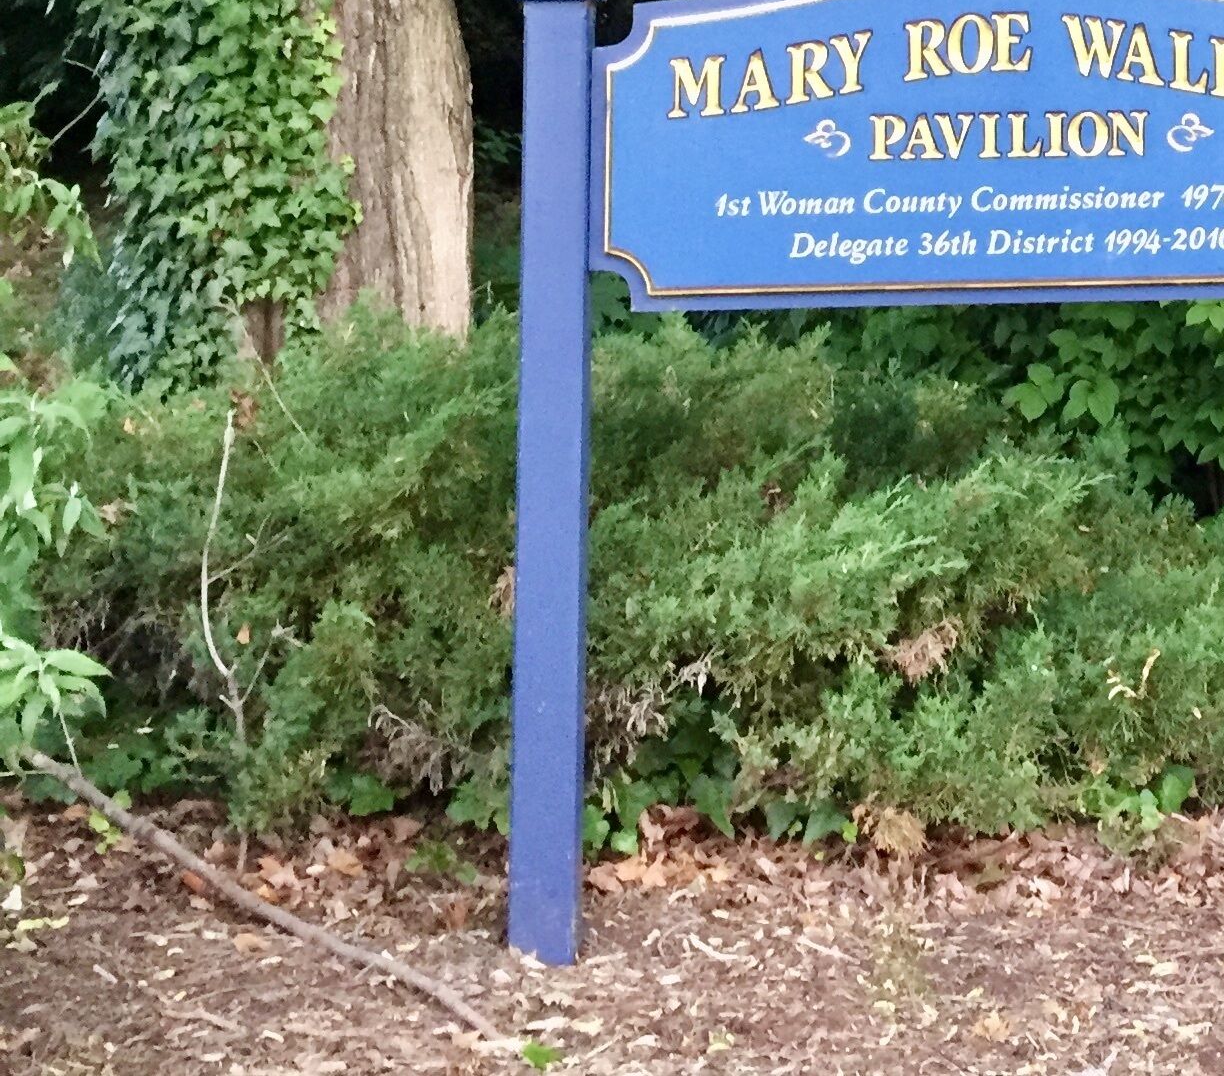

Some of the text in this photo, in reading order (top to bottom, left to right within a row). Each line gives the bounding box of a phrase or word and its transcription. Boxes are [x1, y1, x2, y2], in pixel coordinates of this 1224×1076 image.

[667, 31, 872, 119] MARY
[903, 12, 1032, 82] ROE
[868, 111, 1149, 161] PAVILION
[714, 192, 752, 218] 1st
[757, 190, 856, 217] Woman
[862, 186, 963, 219] County
[970, 185, 1166, 213] Commissioner
[788, 231, 909, 266] Delegate
[917, 229, 977, 257] 36th
[985, 228, 1095, 257] District
